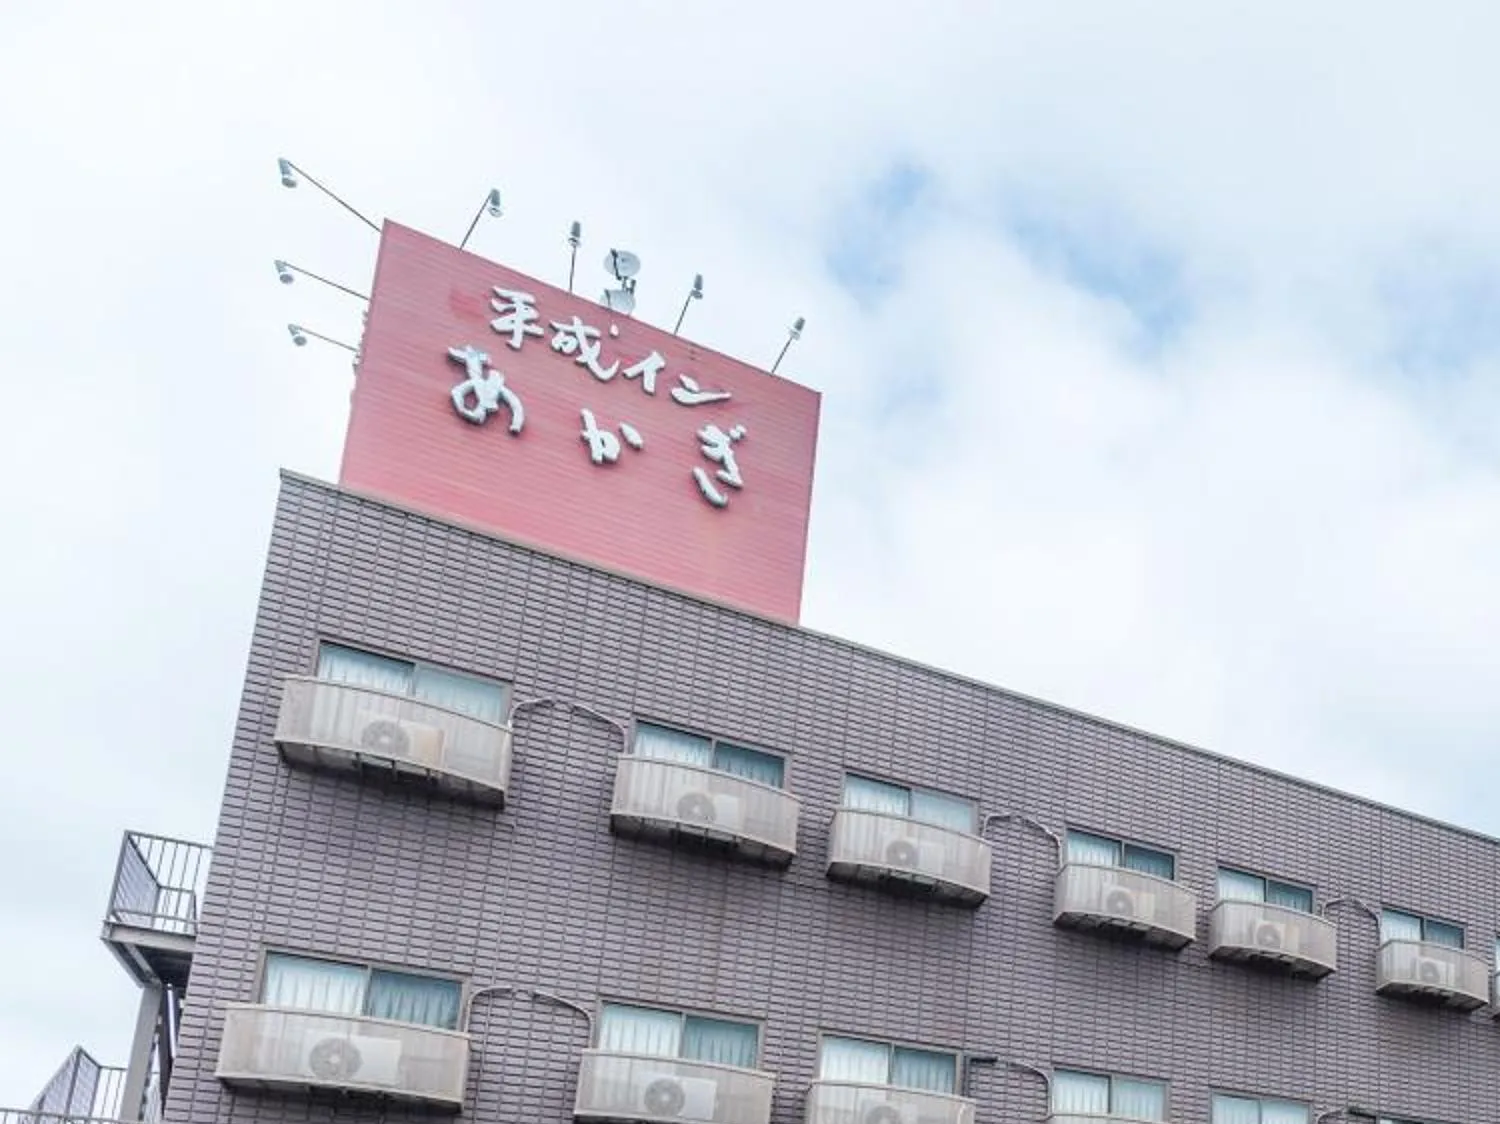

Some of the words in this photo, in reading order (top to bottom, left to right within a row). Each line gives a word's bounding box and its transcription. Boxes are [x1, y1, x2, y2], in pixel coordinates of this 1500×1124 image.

[489, 284, 733, 406] 平成イン
[446, 344, 748, 509] あかぎ
